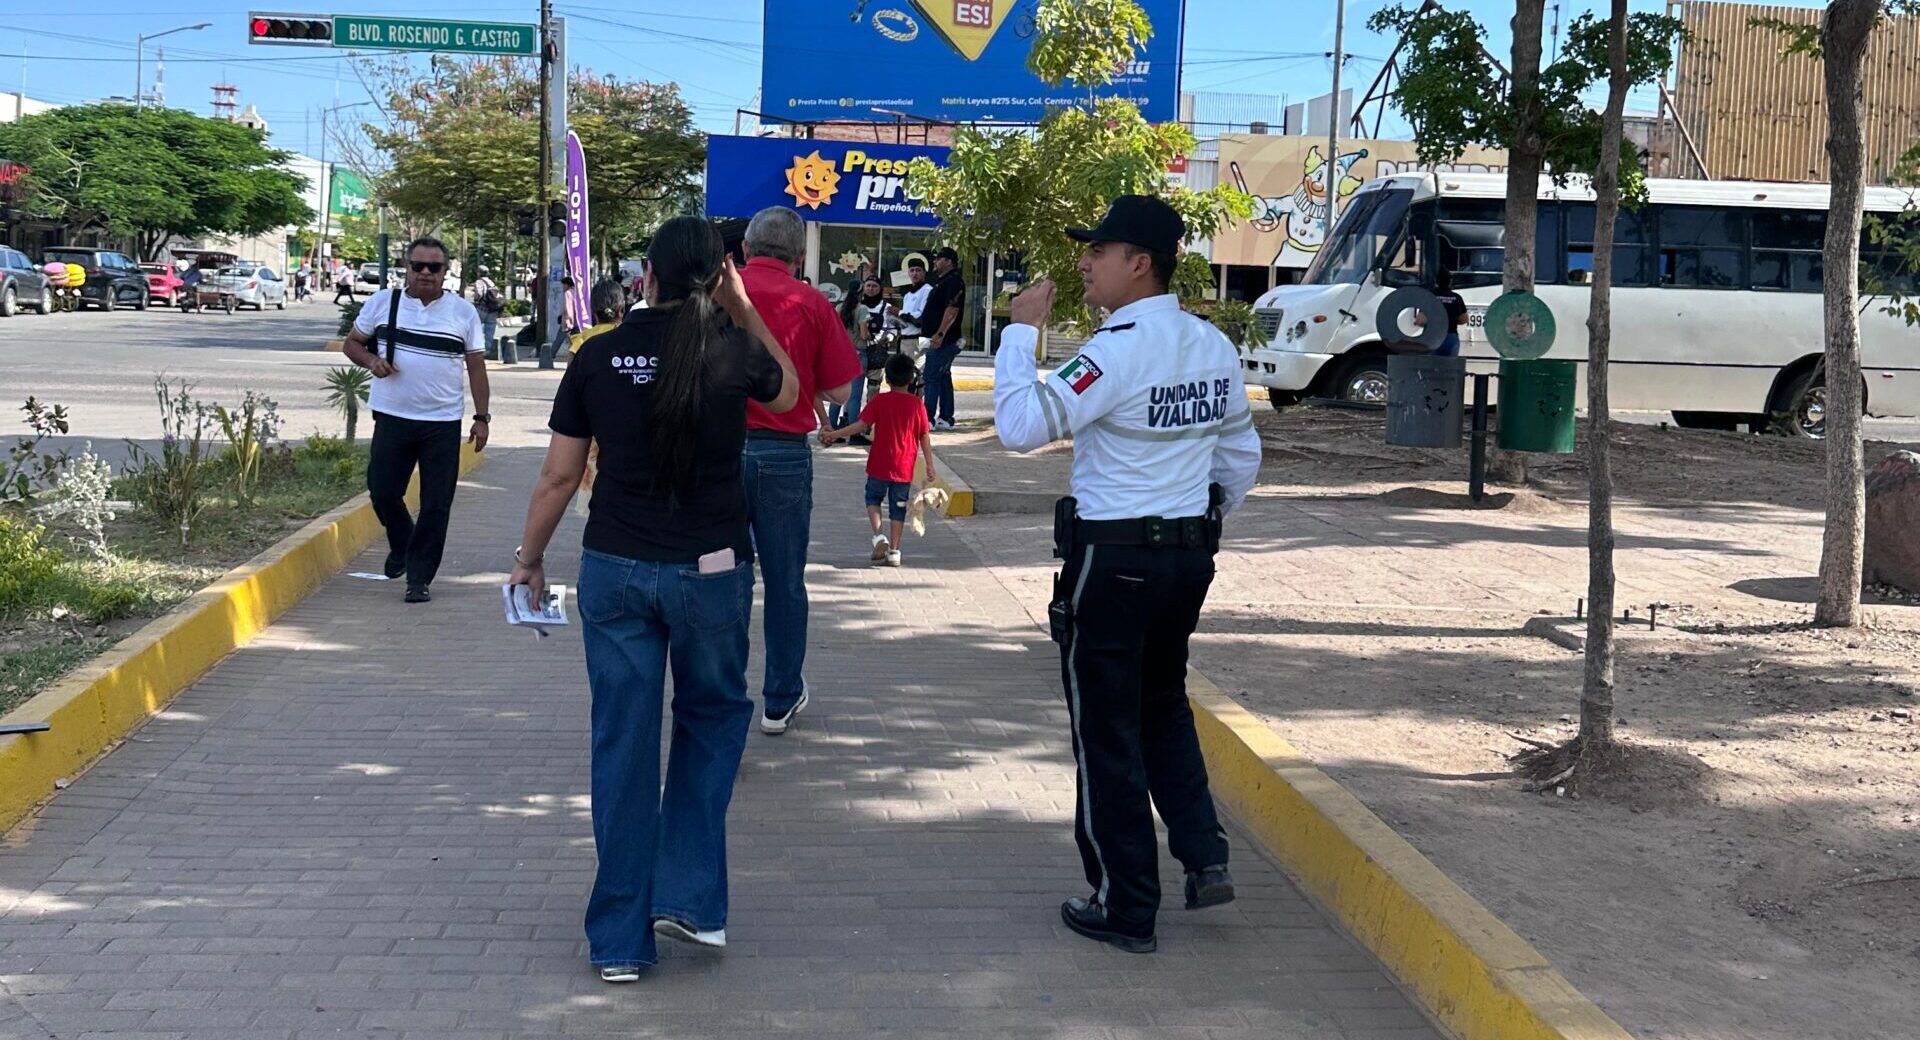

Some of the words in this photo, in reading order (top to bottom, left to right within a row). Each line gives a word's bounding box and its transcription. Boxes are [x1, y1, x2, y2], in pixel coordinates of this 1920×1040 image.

[957, 3, 990, 25] ES!
[350, 23, 383, 42] BLVD.
[389, 25, 449, 44] ROSENDO
[455, 28, 466, 46] G.
[472, 29, 520, 48] CASTRO
[942, 97, 966, 105] Matriz
[967, 97, 990, 107] Leyva
[1045, 97, 1072, 106] Centro
[869, 201, 914, 214] Empeños,
[1150, 380, 1208, 406] UNIDAD
[1214, 378, 1230, 397] DE
[1148, 397, 1227, 428] VIALIDAD
